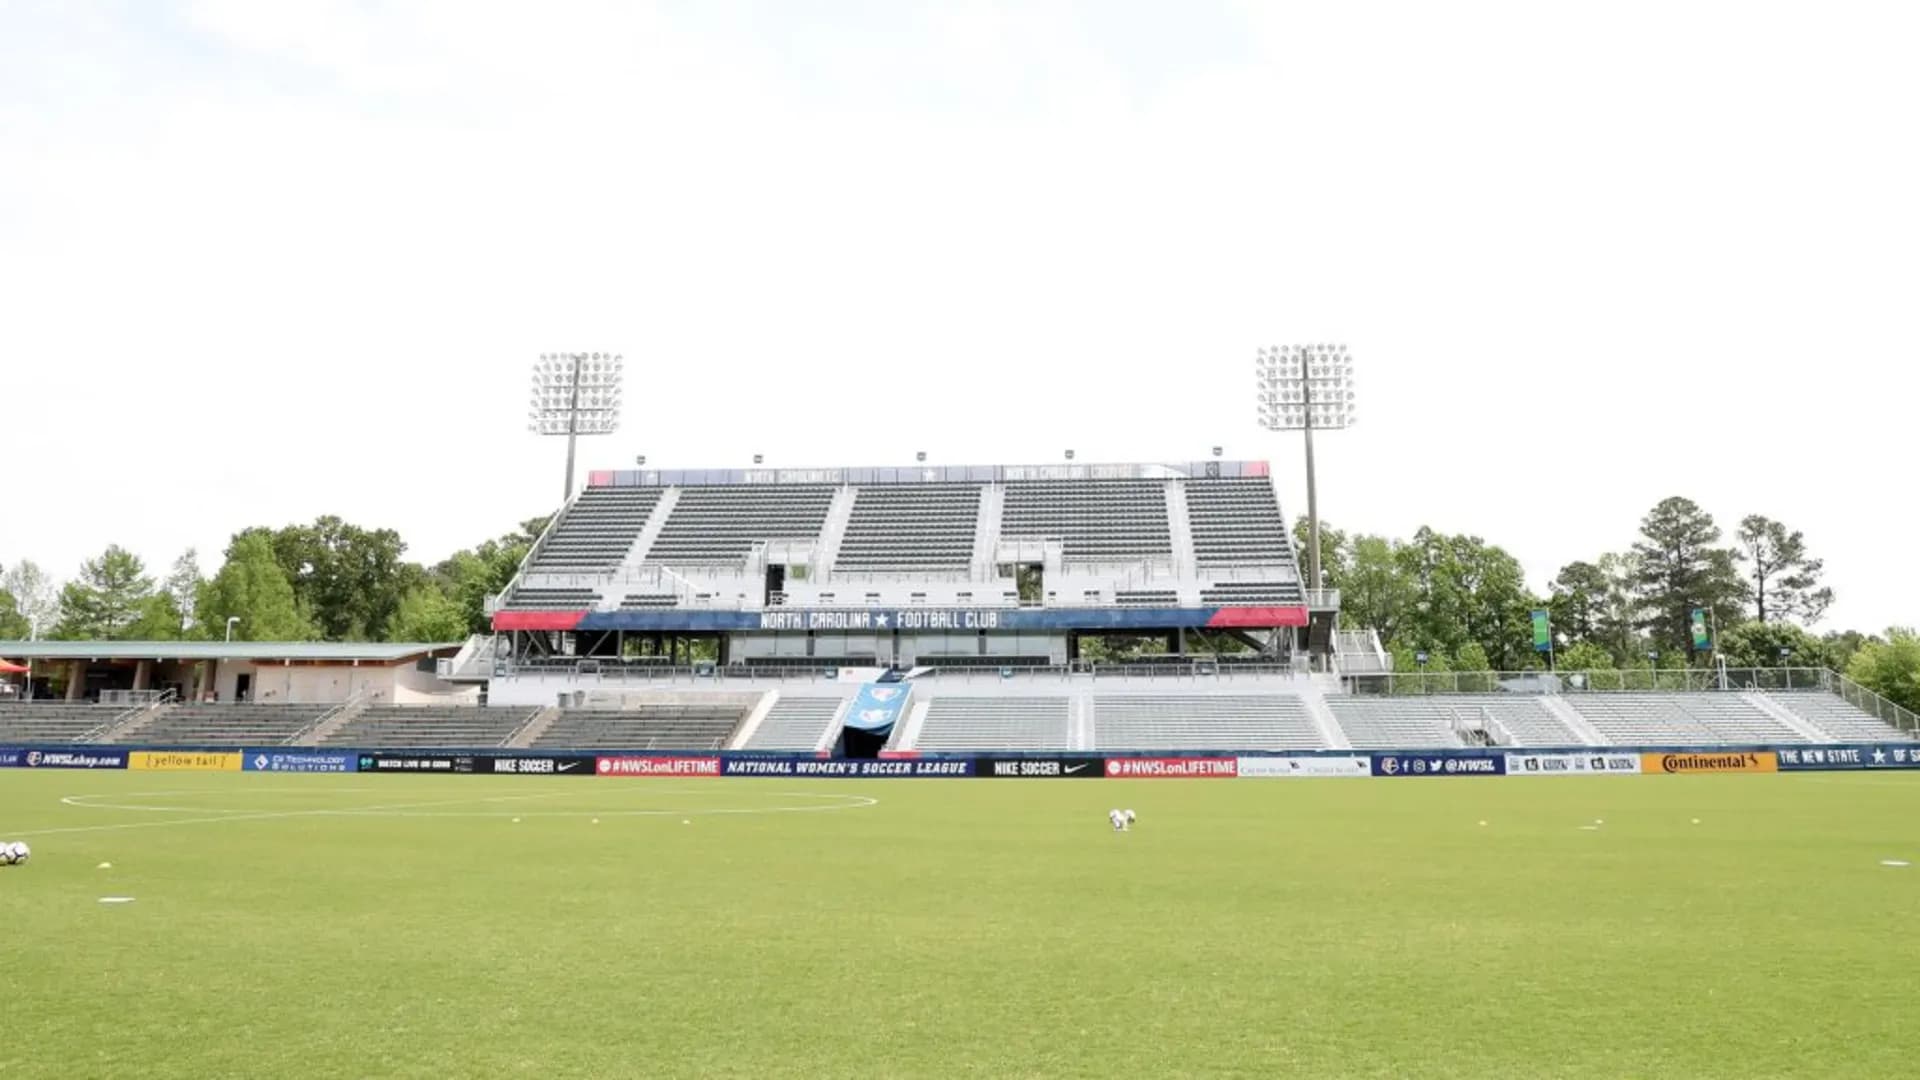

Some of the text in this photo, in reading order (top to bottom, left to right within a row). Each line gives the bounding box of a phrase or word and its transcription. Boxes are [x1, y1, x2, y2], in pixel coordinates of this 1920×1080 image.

[761, 611, 997, 629] NORTH CAROLINA FOOTBALL CLUB
[1662, 754, 1746, 773] Continental
[1780, 749, 1799, 764] THE
[1802, 749, 1824, 764] NEW
[1828, 749, 1860, 763] STATE
[1893, 749, 1906, 762] OF
[494, 759, 554, 772] NIKE SOCCER
[612, 759, 718, 773] #NWSLonLIFETIME
[727, 761, 967, 773] NATIONAL WOMEN'S SOCCER LEAGUE
[994, 762, 1060, 775] NIKE SOCCER
[1122, 760, 1235, 774] #NWSLonLIFETIME
[1445, 760, 1496, 772] @NWSL
